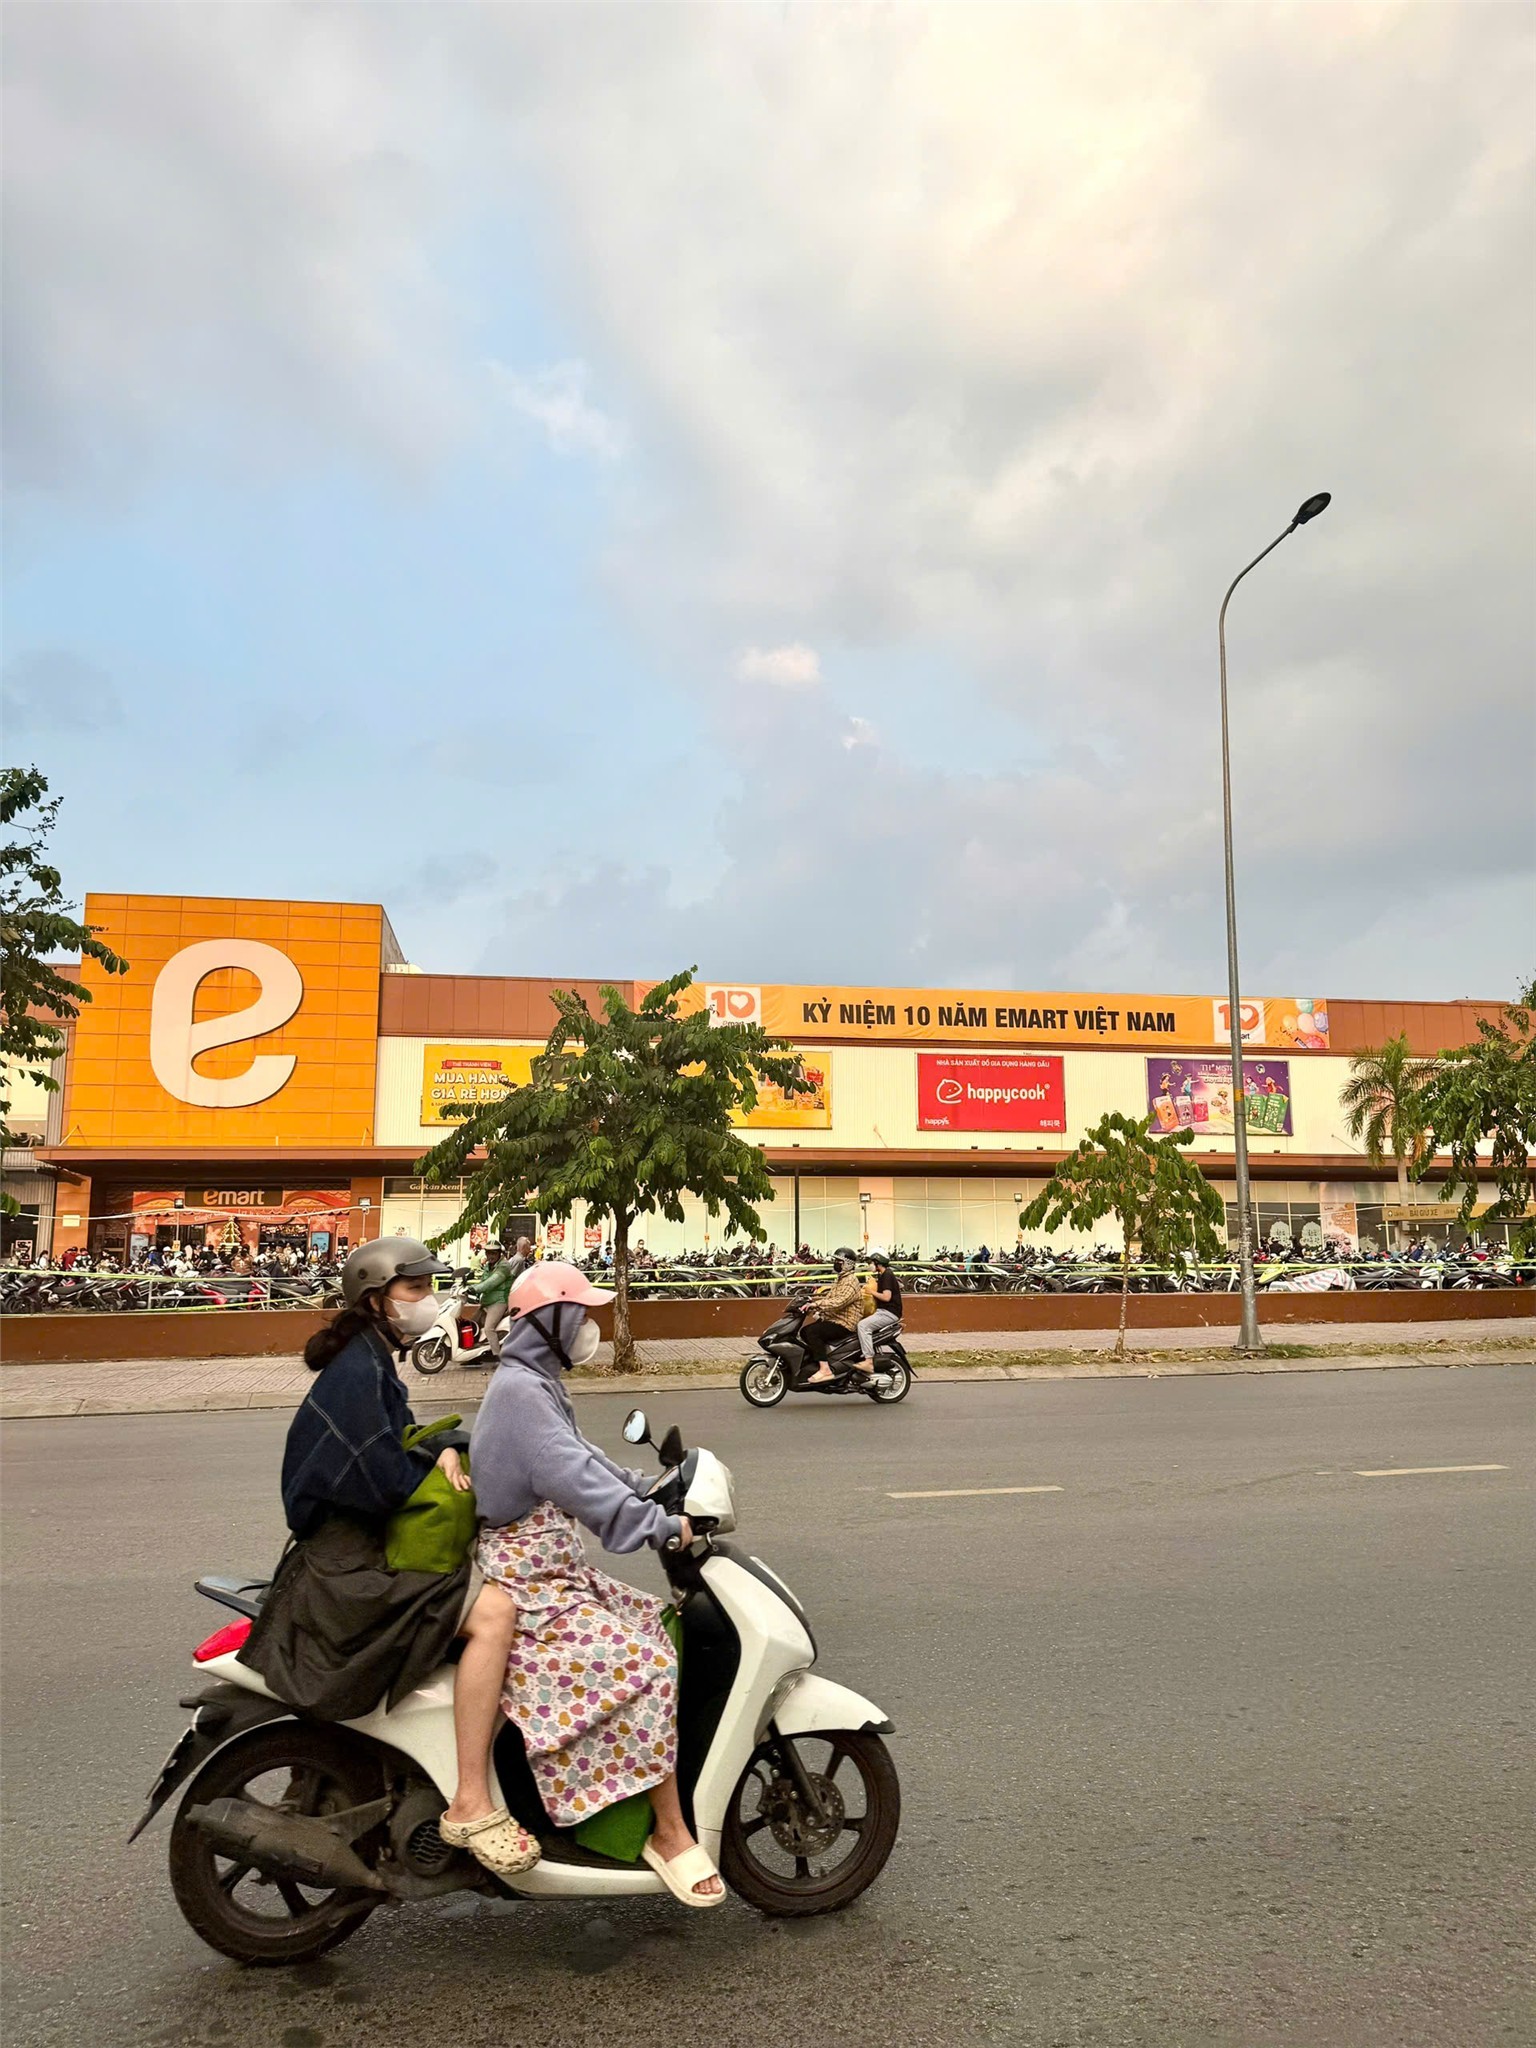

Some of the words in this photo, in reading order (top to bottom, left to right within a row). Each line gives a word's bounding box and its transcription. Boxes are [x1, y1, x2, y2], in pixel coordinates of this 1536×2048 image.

[150, 938, 303, 1108] e
[803, 997, 832, 1023] KỶ
[840, 1000, 895, 1029] NIỆM
[904, 1006, 930, 1026] 10
[938, 1002, 987, 1027] NĂM
[995, 1008, 1068, 1029] EMART
[1074, 1006, 1119, 1034] VIỆT
[1127, 1012, 1175, 1032] NAM
[434, 1072, 466, 1084] MUA
[468, 1071, 509, 1084] HÀNG
[431, 1086, 457, 1099] GIÁ
[460, 1085, 477, 1099] RẺ
[967, 1083, 1045, 1104] happycook
[203, 1188, 265, 1206] emart
